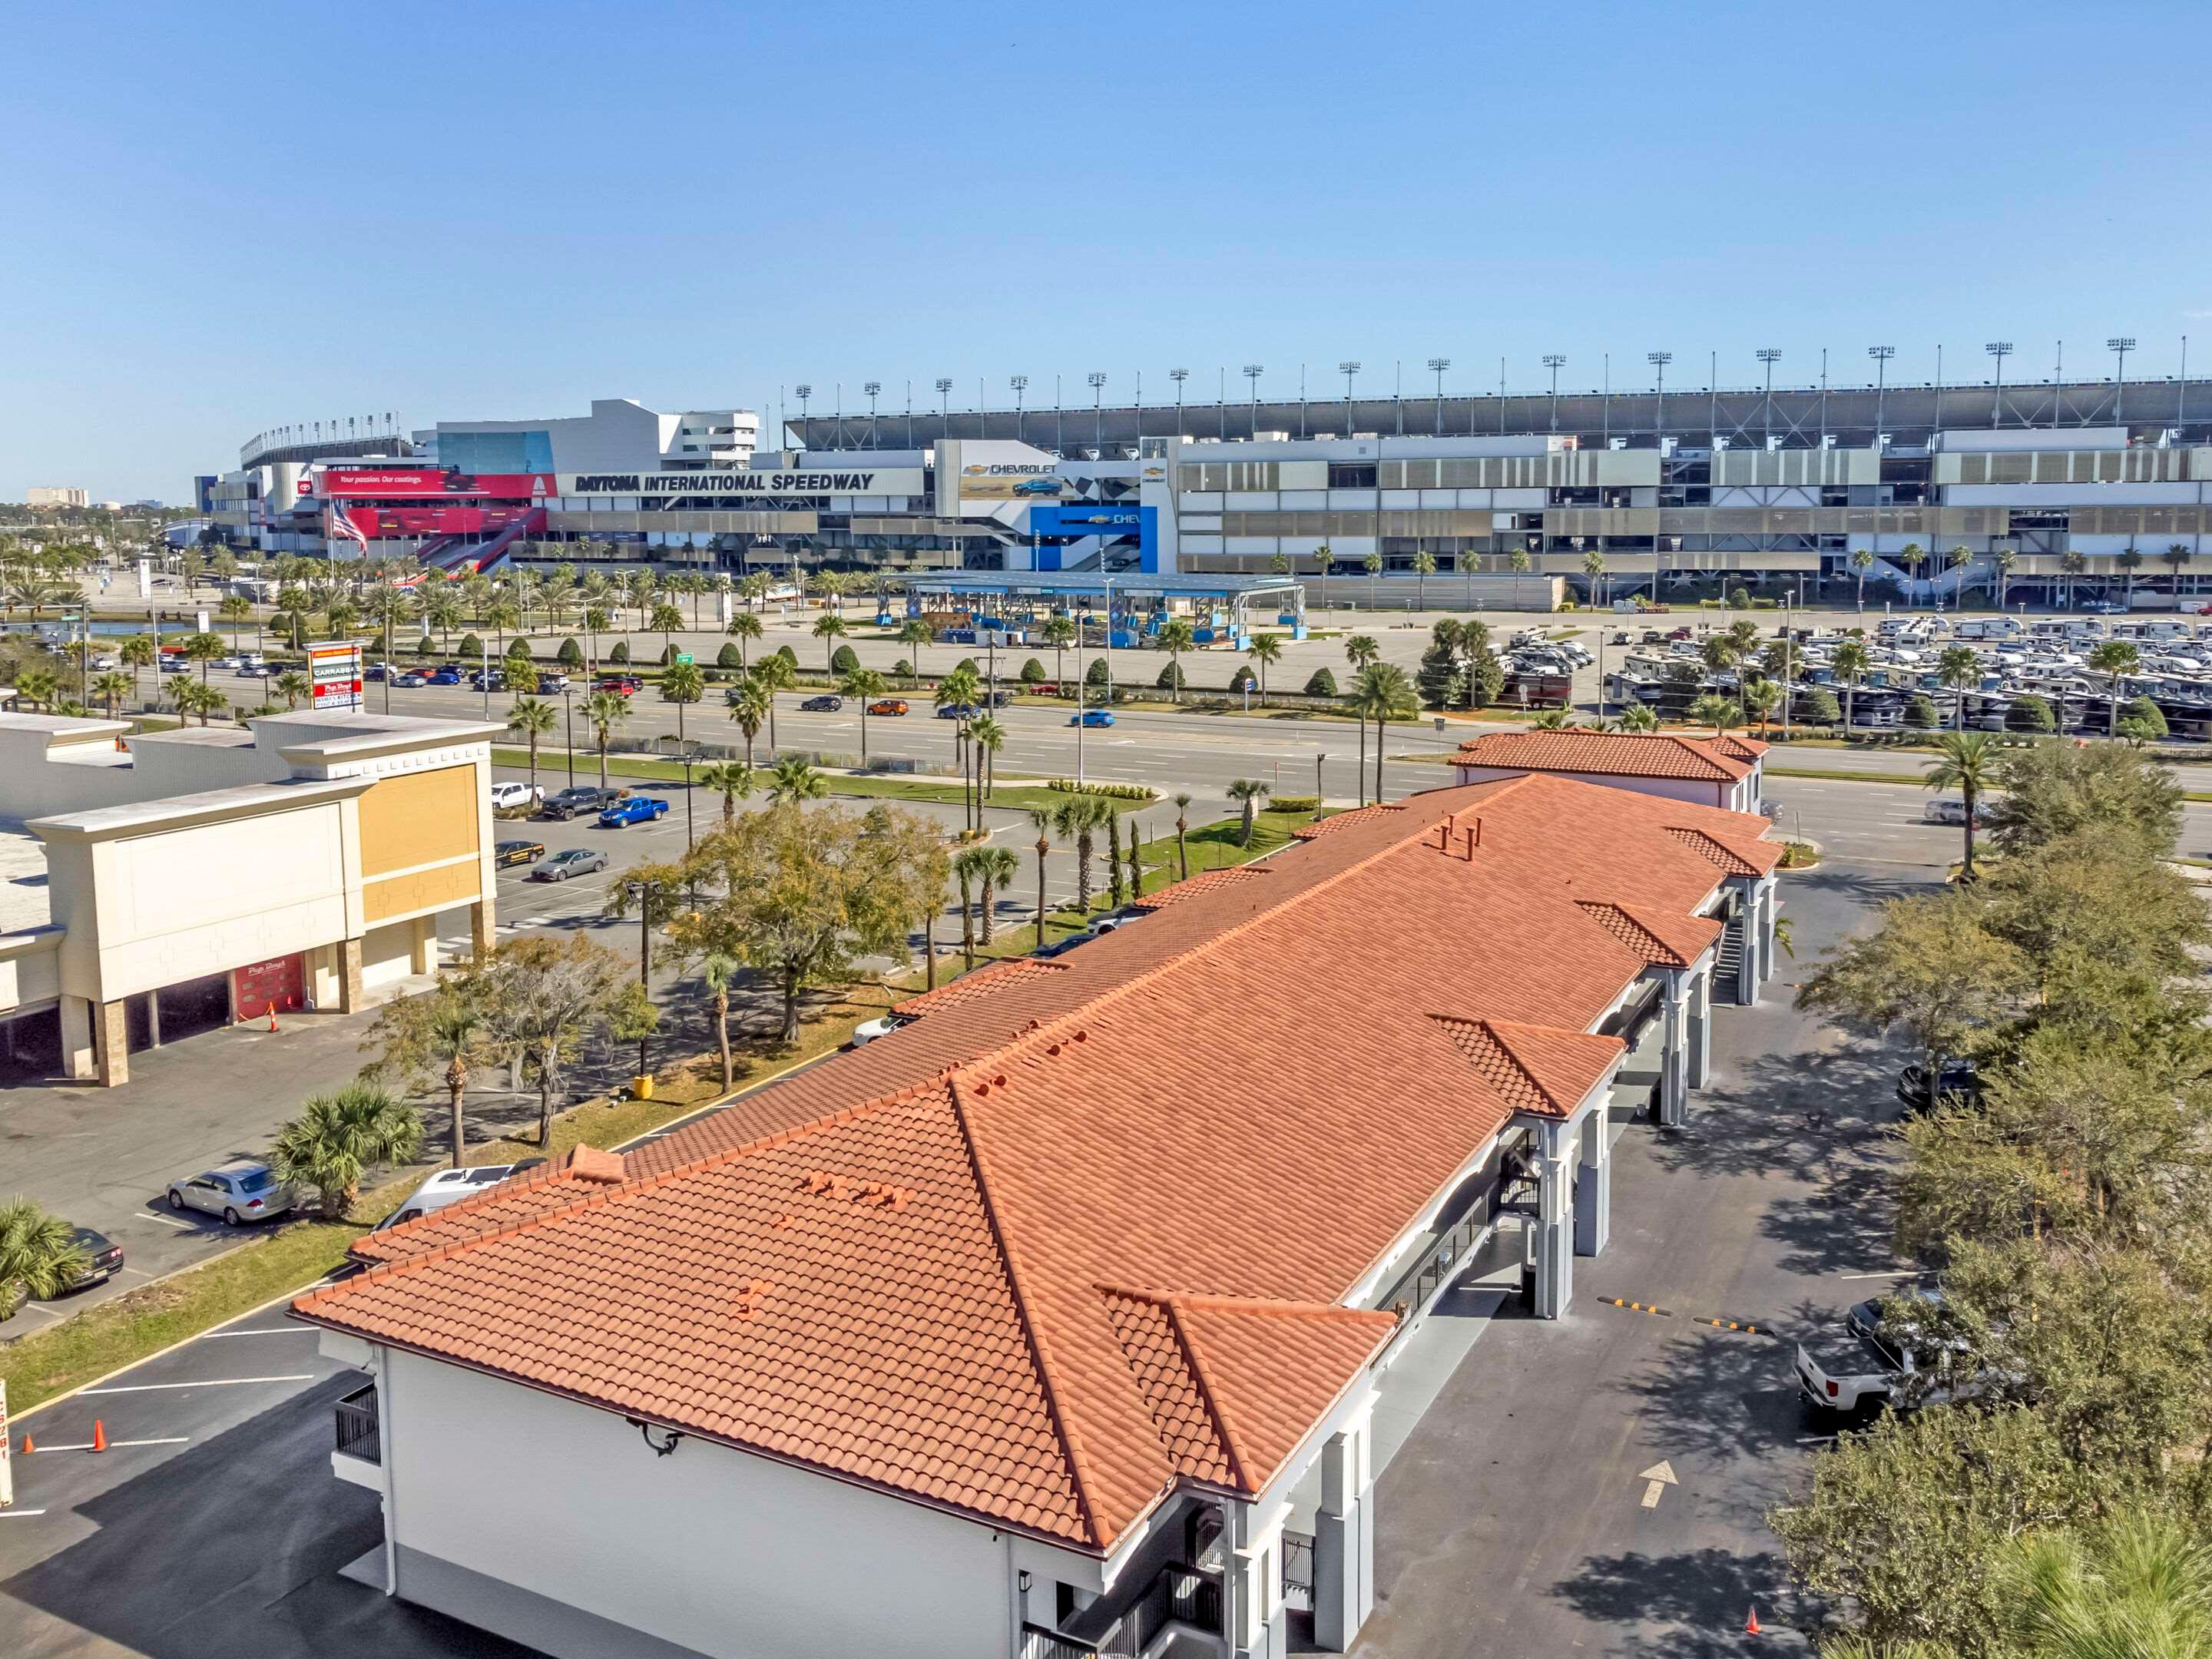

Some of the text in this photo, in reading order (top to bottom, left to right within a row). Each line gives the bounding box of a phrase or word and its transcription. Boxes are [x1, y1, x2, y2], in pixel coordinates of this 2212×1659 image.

[990, 465, 1057, 474] CHEVROLET
[575, 474, 874, 492] DAYTONA INTERNATIONAL SPEEDWAY
[314, 666, 361, 677] CARRABBAS
[265, 960, 286, 969] Boys
